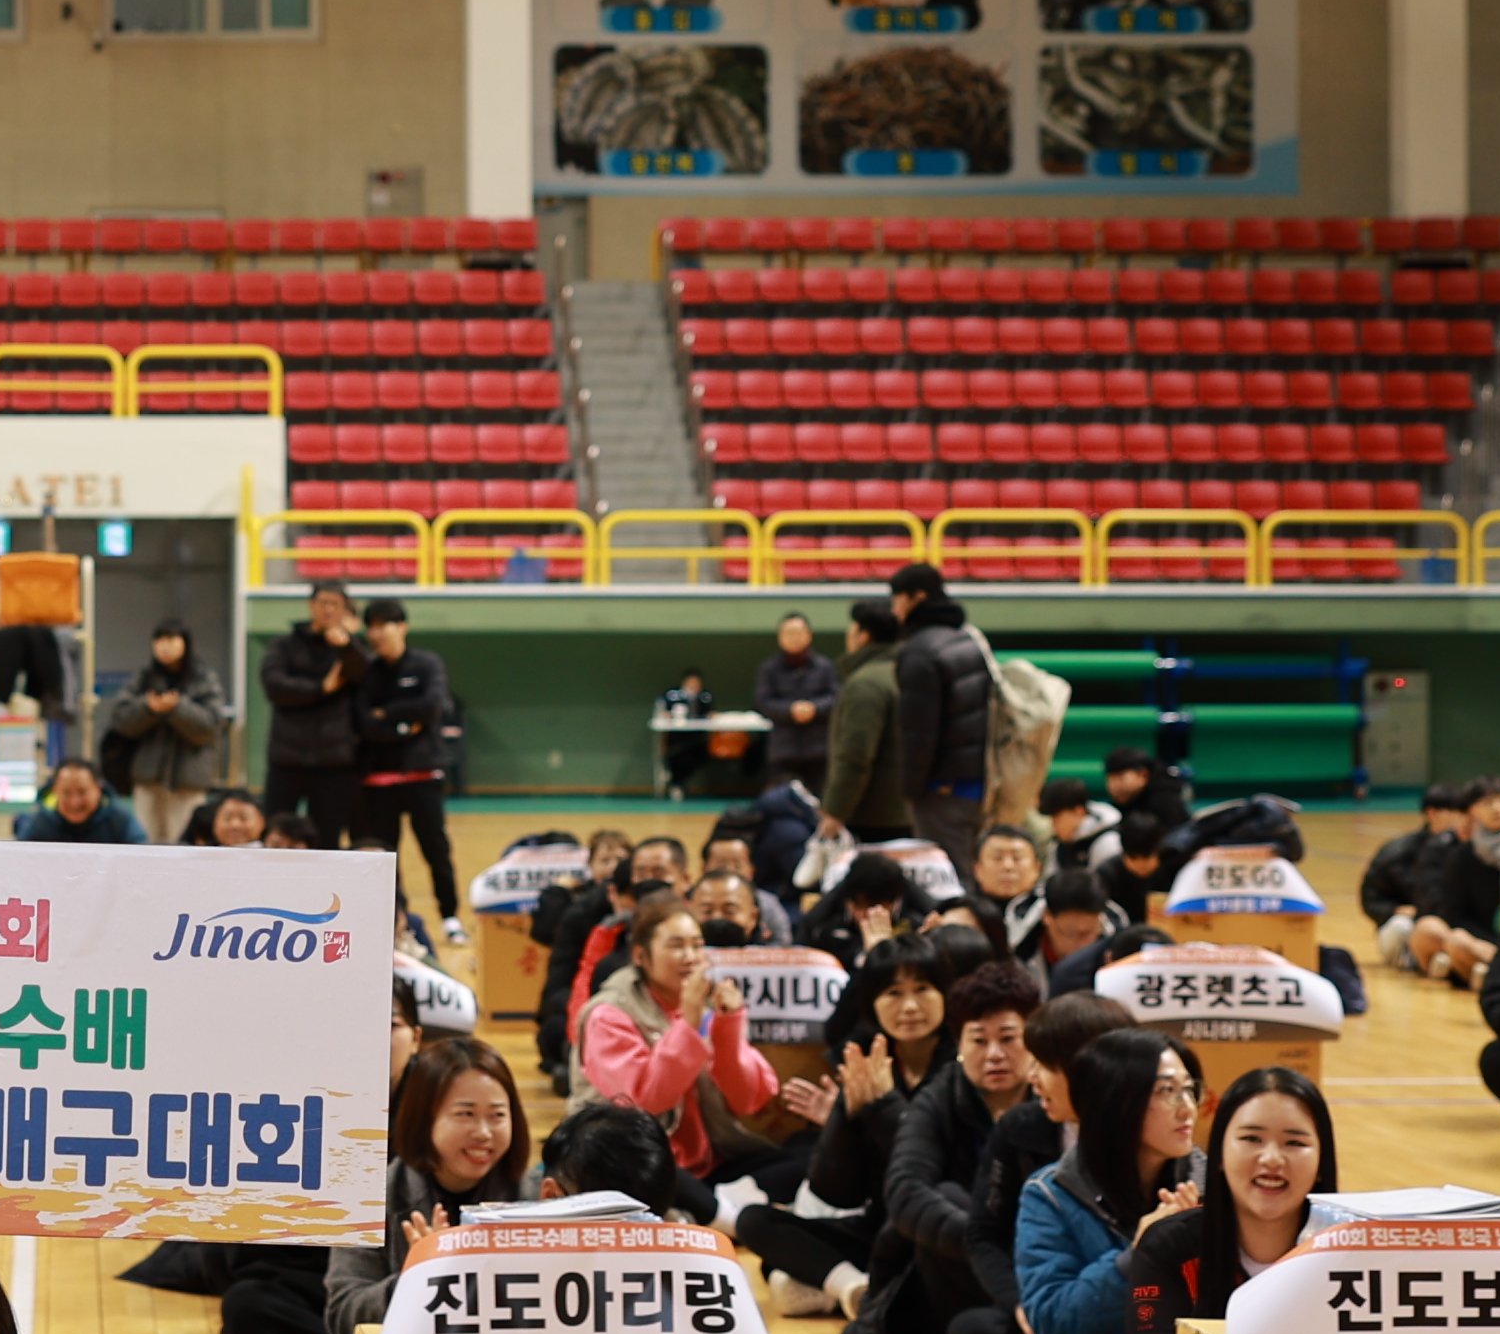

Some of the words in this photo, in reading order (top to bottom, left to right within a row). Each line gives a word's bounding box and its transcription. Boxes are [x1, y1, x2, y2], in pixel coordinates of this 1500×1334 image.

[153, 913, 318, 962] Jindo
[1135, 974, 1305, 1008] 광주렛츠고
[437, 1228, 489, 1251] 제10회
[493, 1228, 578, 1248] 진도군수배
[581, 1227, 616, 1247] 전국
[620, 1227, 653, 1247] 남여
[1370, 1227, 1455, 1247] 진도군수배
[1458, 1227, 1492, 1247] 전국
[425, 1270, 737, 1334] 진도아리랑
